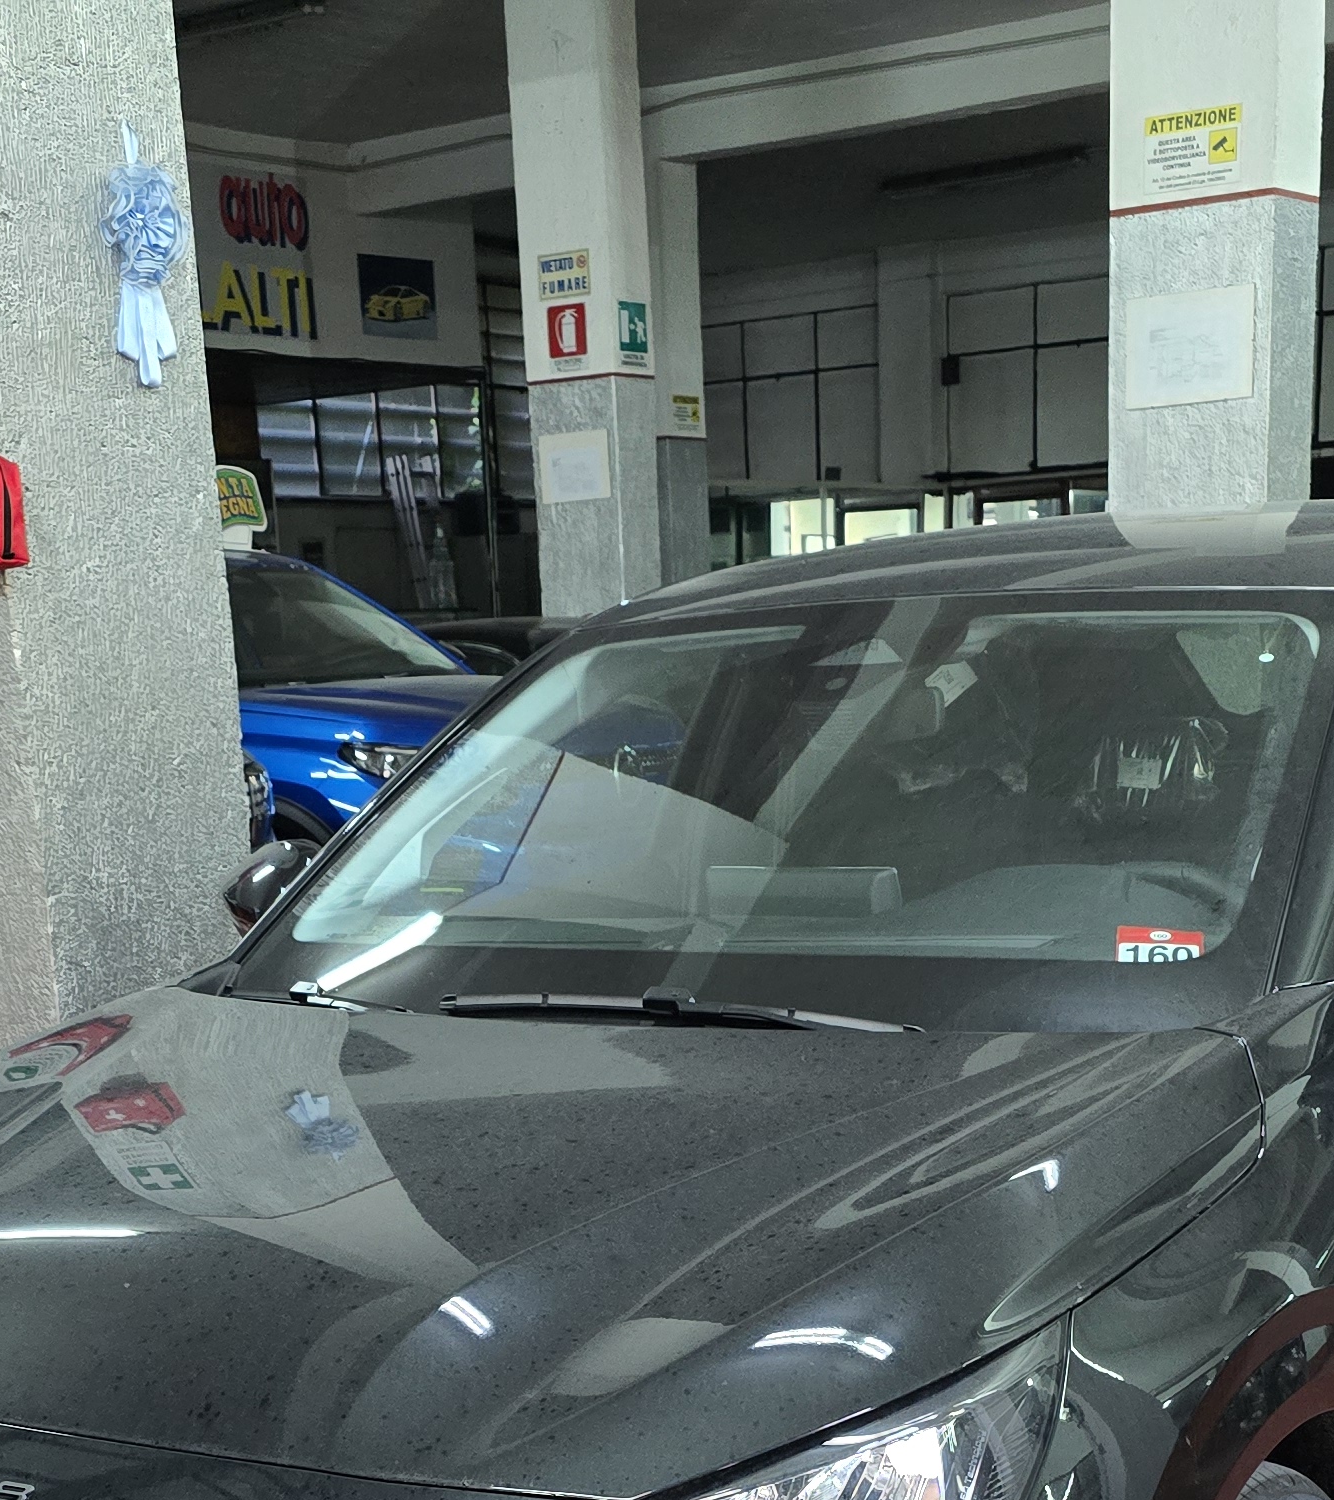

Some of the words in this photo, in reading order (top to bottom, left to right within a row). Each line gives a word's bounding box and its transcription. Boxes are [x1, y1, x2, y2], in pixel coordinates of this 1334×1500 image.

[1149, 106, 1237, 134] ATTENZIONE
[219, 172, 309, 248] auto
[541, 256, 574, 274] VIETATO
[202, 260, 316, 338] ALTI
[542, 276, 588, 295] FUMARE
